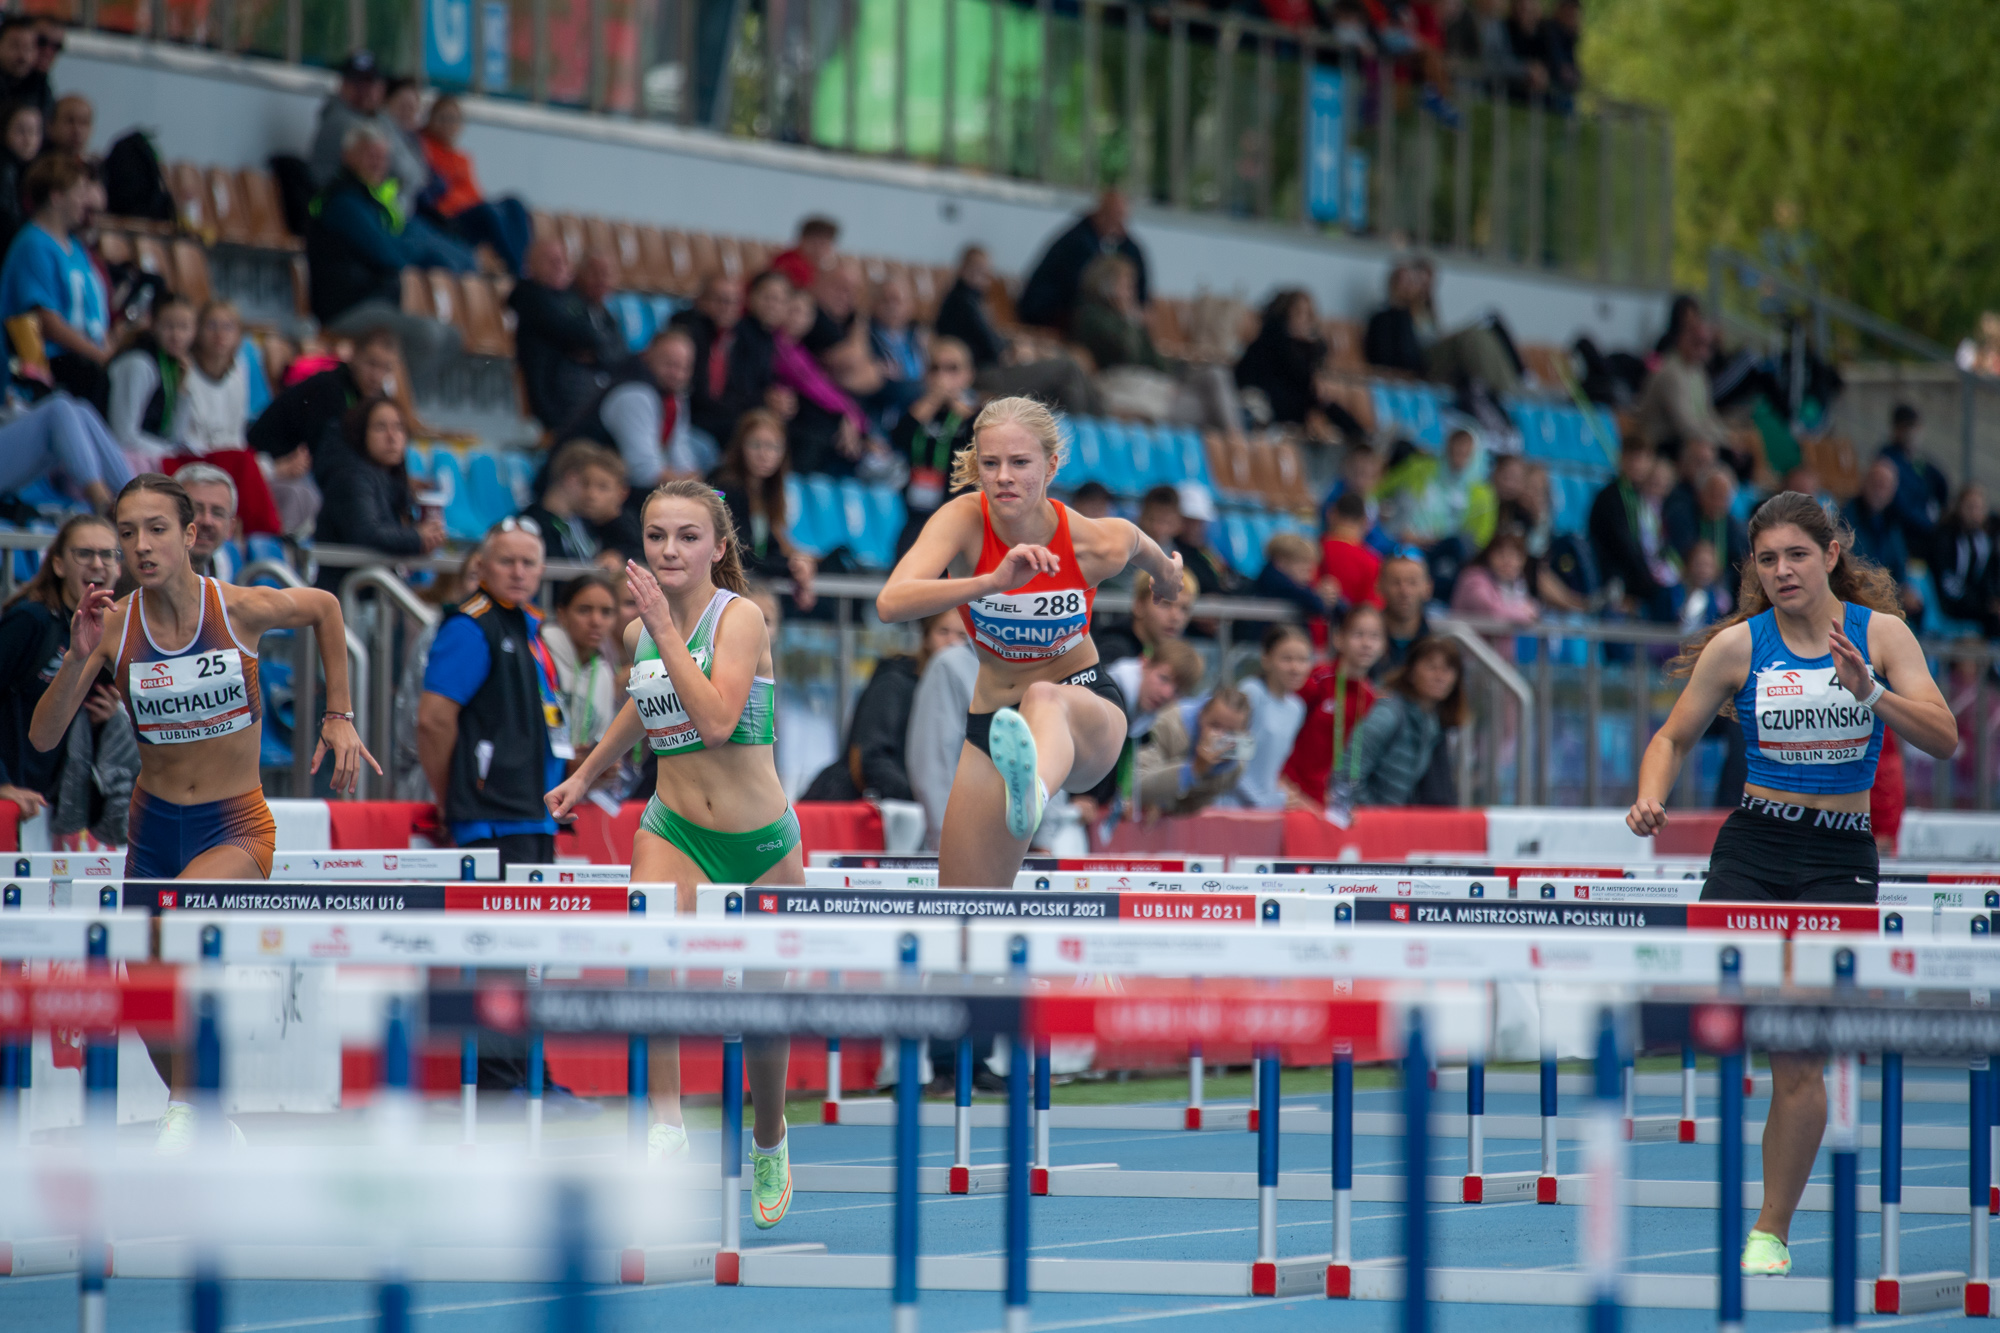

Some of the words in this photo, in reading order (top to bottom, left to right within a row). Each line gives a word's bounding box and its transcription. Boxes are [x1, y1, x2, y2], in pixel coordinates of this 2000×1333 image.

[985, 602, 1022, 613] FUEL
[1033, 593, 1080, 617] 288
[974, 617, 1083, 643] ZOCHNIAK
[992, 644, 1033, 659] LUBLIN
[1037, 645, 1068, 659] 2022
[196, 654, 227, 678] 25
[141, 677, 173, 688] ORLEN
[1071, 670, 1098, 685] PRO
[1767, 685, 1802, 696] ORLEN
[136, 684, 243, 717] MICHALUK
[1761, 703, 1872, 730] CZUPRYŃSKA
[159, 730, 201, 741] LUBLIN
[204, 721, 234, 736] 2022
[654, 736, 680, 748] LUBLIN
[1780, 750, 1823, 761] LUBLIN
[1827, 748, 1858, 760] 2022
[1749, 797, 1806, 822] PRO
[1813, 809, 1871, 831] NIKE
[322, 858, 364, 870] polanik
[1157, 884, 1187, 892] FUEL
[1338, 884, 1378, 895] polanik
[184, 895, 219, 910] PZLA
[221, 896, 321, 910] MISTRZOSTWA
[325, 896, 374, 911] POLSKI
[378, 897, 405, 911] U16
[482, 897, 542, 911] LUBLIN
[549, 897, 592, 911] 2022
[786, 898, 820, 913] PZLA
[824, 898, 914, 914] DRUŻYNOWE
[917, 901, 1017, 916] MISTRZOSTWA
[1020, 903, 1070, 917] POLSKI
[1072, 903, 1106, 917] 2021
[1133, 904, 1194, 918] LUBLIN
[1201, 905, 1243, 919] 2021
[1417, 908, 1452, 923] PZLA
[1455, 909, 1560, 925] MISTRZOSTWA
[1563, 911, 1614, 927] POLSKI
[1618, 913, 1646, 927] U16
[1727, 915, 1789, 930] LUBLIN
[1797, 916, 1841, 931] 2022
